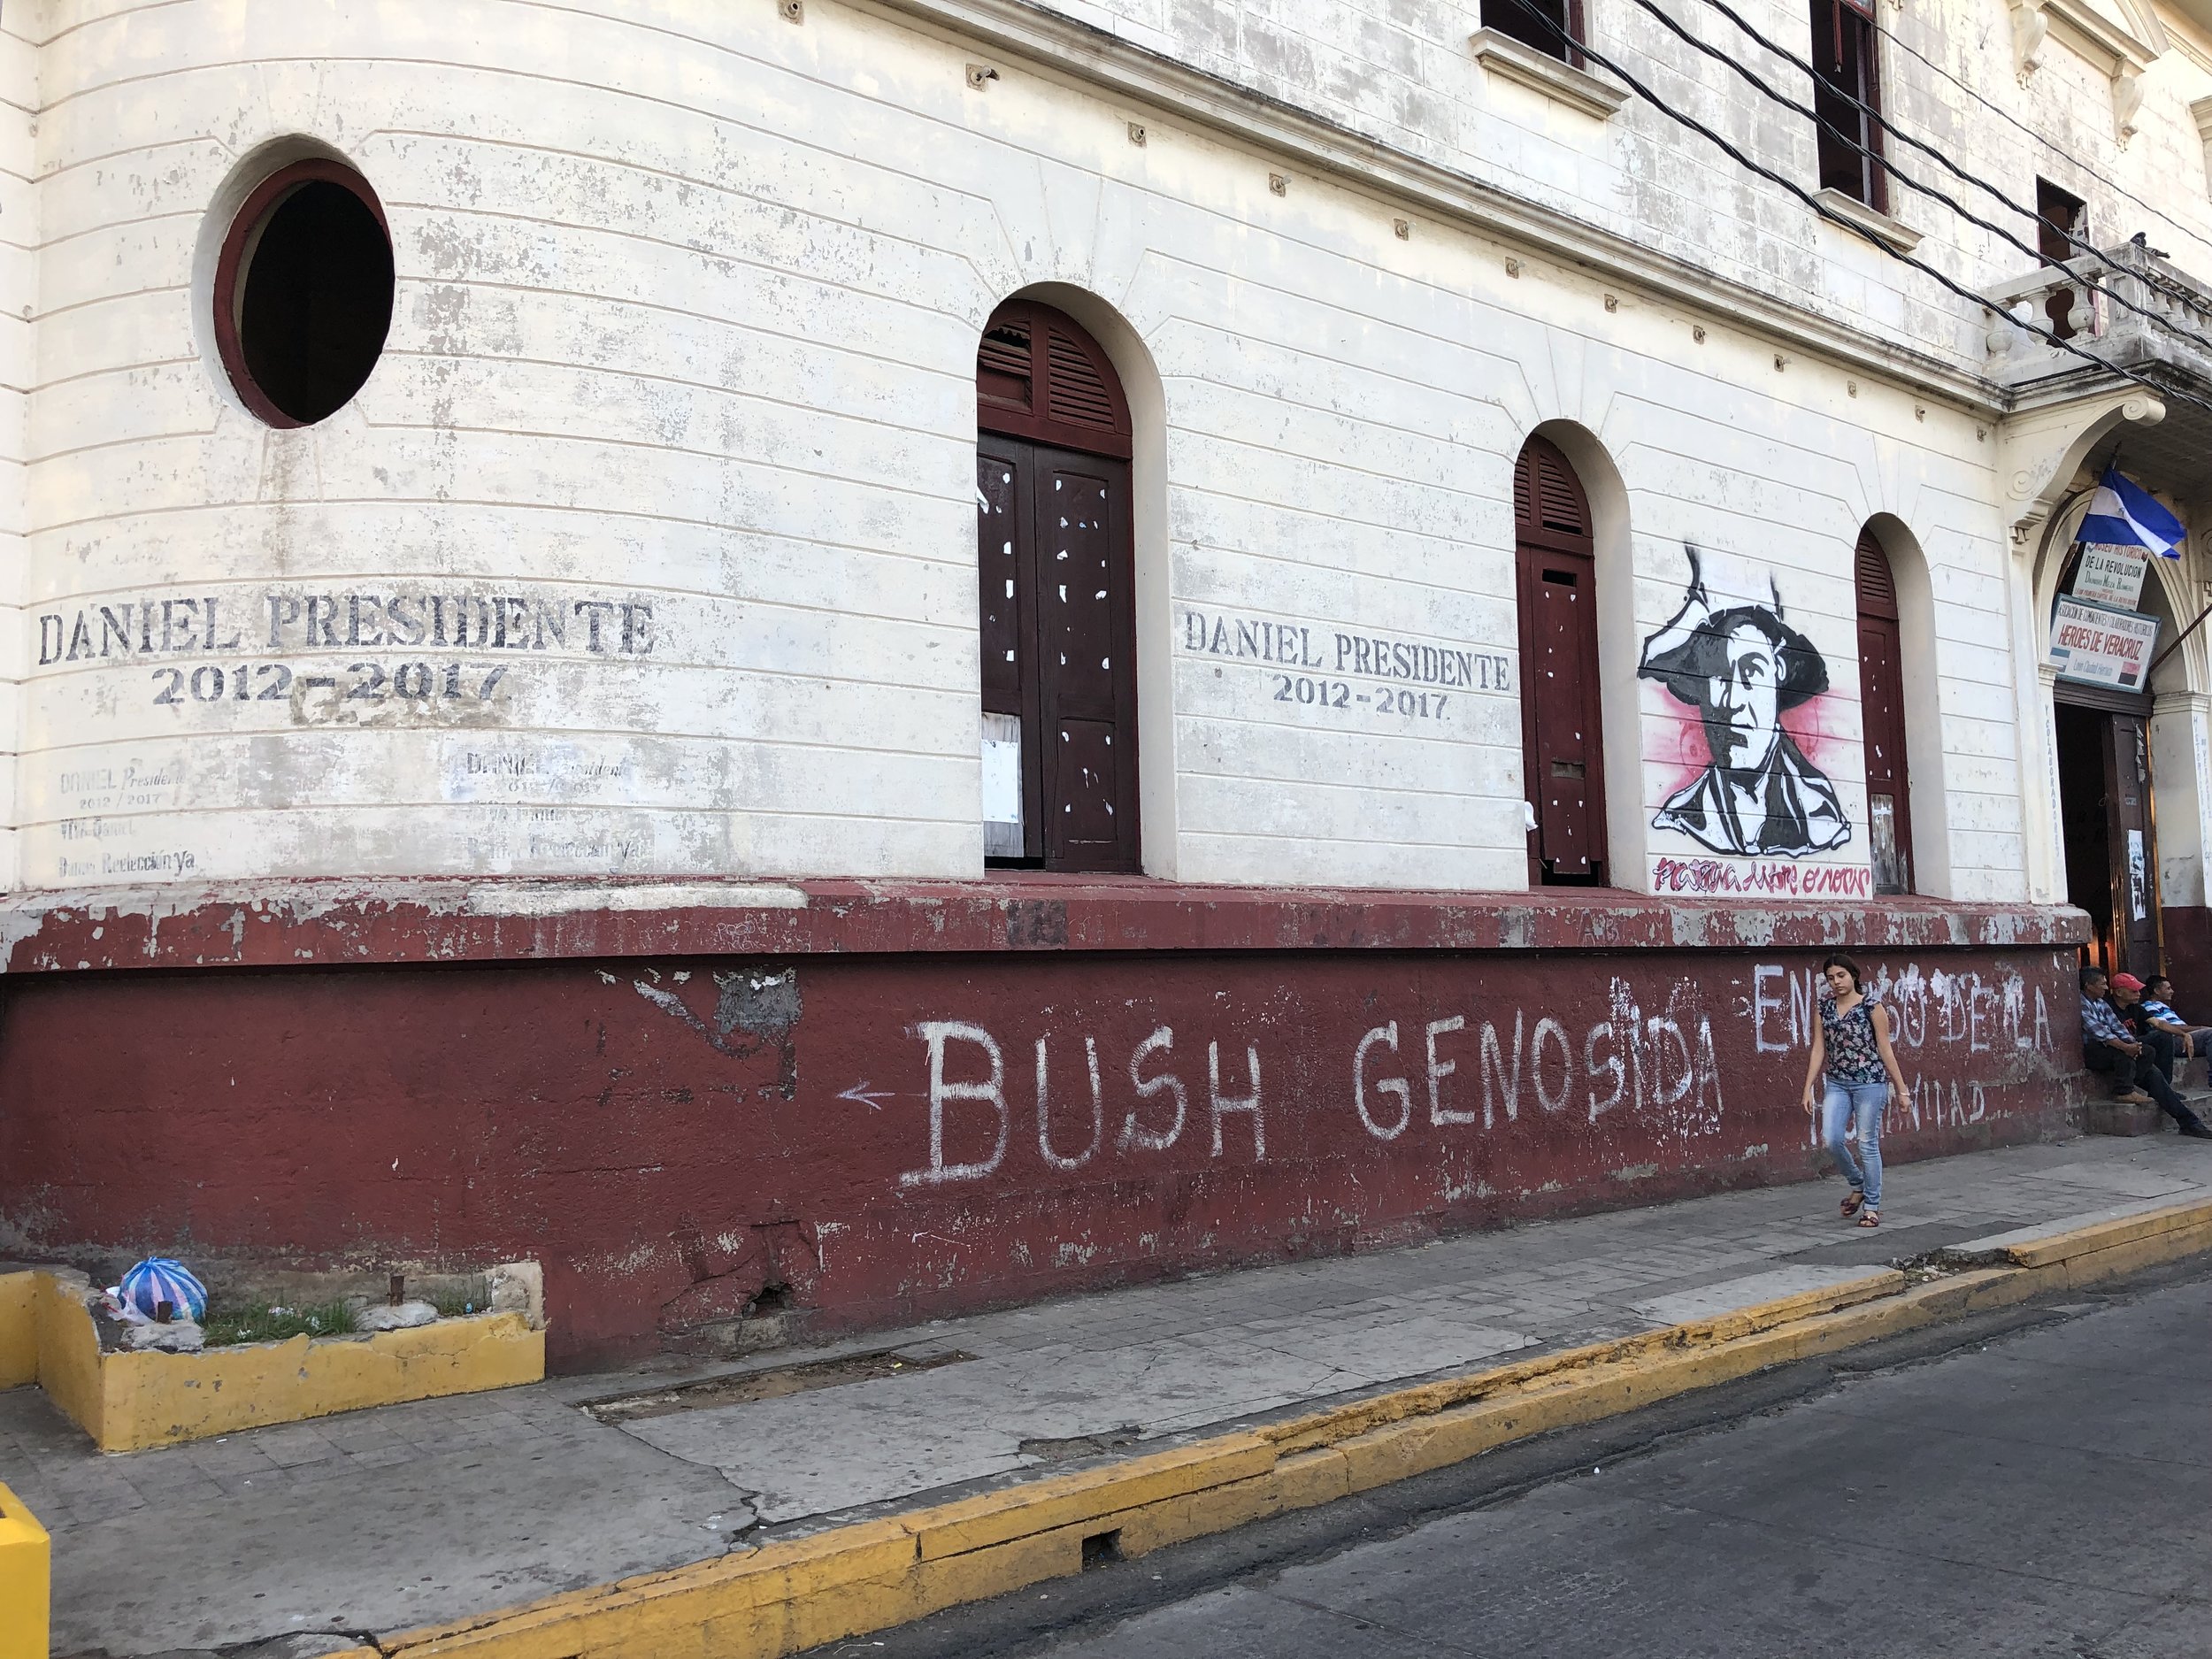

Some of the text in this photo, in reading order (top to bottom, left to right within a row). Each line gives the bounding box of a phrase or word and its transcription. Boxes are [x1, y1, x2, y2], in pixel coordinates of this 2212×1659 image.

[2085, 555, 2095, 568] DE
[2094, 557, 2104, 571] LA
[2104, 560, 2142, 579] REVOLUCION
[38, 594, 655, 665] DANIEL PRESIDENTE
[1185, 611, 1510, 692] DANIEL PRESIDENTE
[2057, 624, 2144, 661] HEROES DE VERACRUZ
[899, 1003, 1724, 1187] BUSH GENOSIDA
